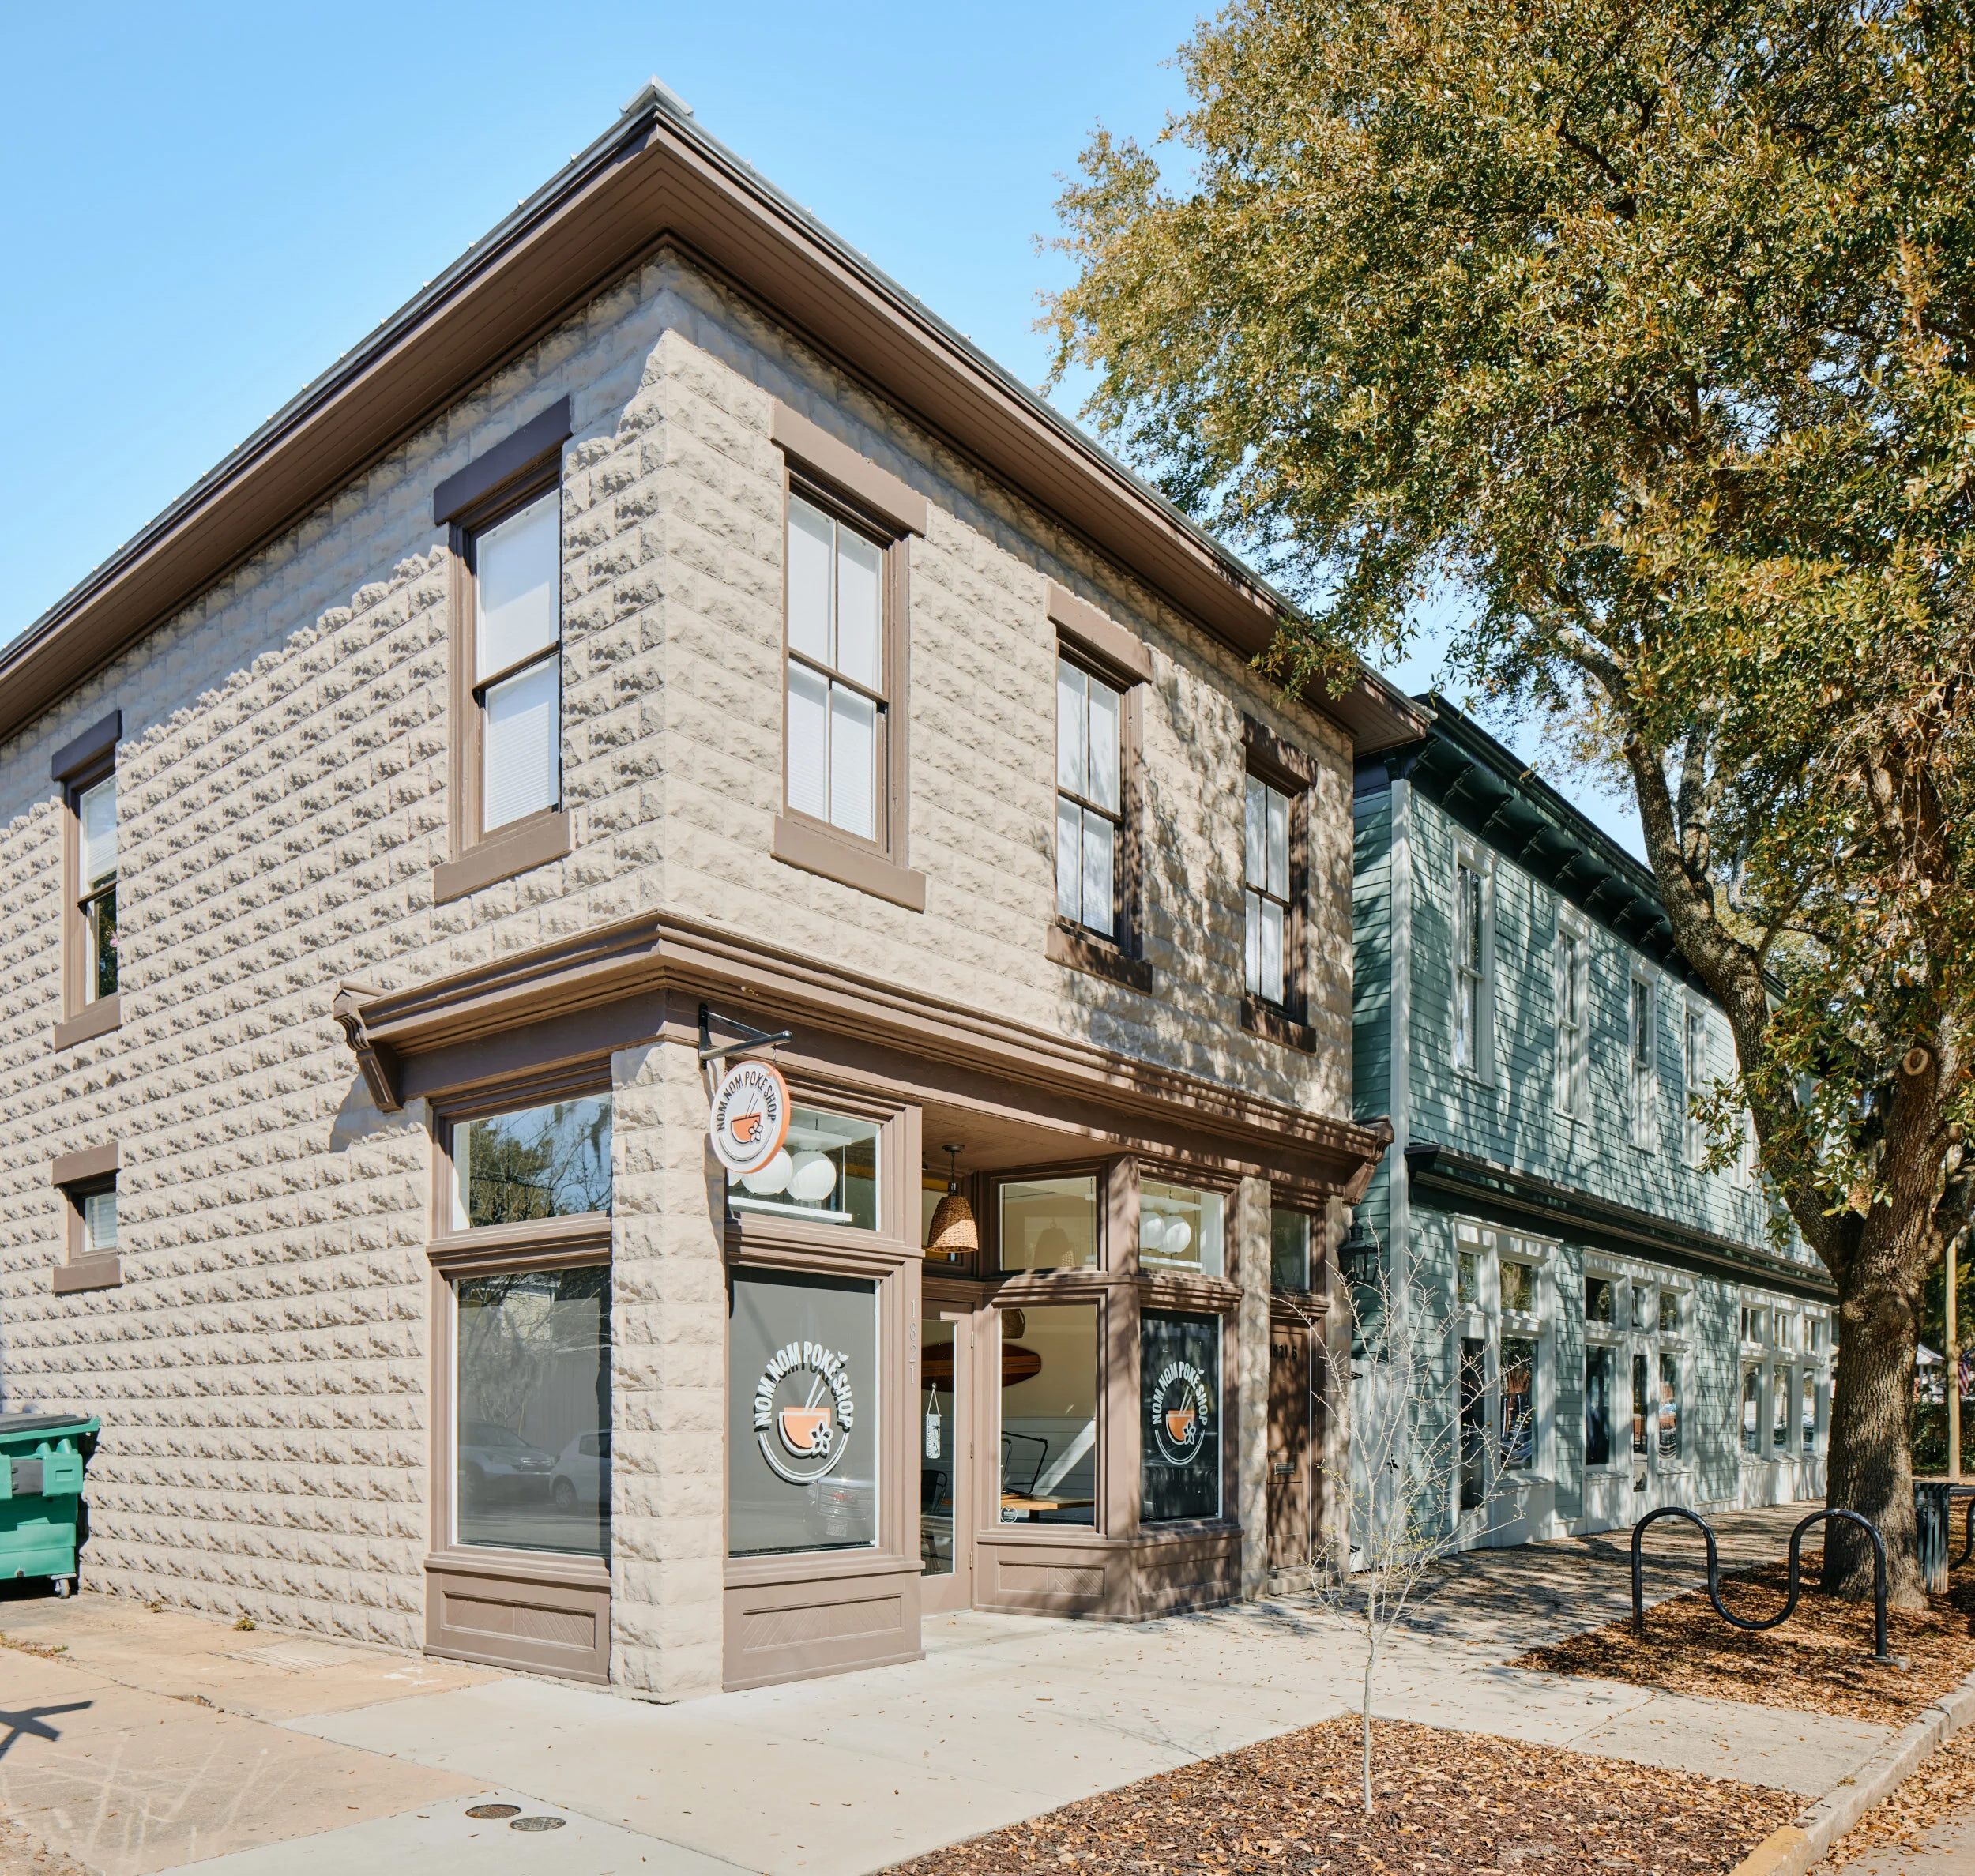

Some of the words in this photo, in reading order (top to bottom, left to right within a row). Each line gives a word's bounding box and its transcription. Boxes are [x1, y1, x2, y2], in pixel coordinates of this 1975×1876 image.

[717, 1100, 728, 1132] NOM
[724, 1076, 743, 1100] NOM
[763, 1085, 777, 1123] SHOP
[754, 1376, 777, 1427] NOM
[766, 1341, 802, 1382] NOM
[833, 1373, 854, 1428] SHOP
[1152, 1388, 1164, 1425] NOM
[1158, 1362, 1179, 1391] NOM
[1195, 1383, 1208, 1426] SHOP
